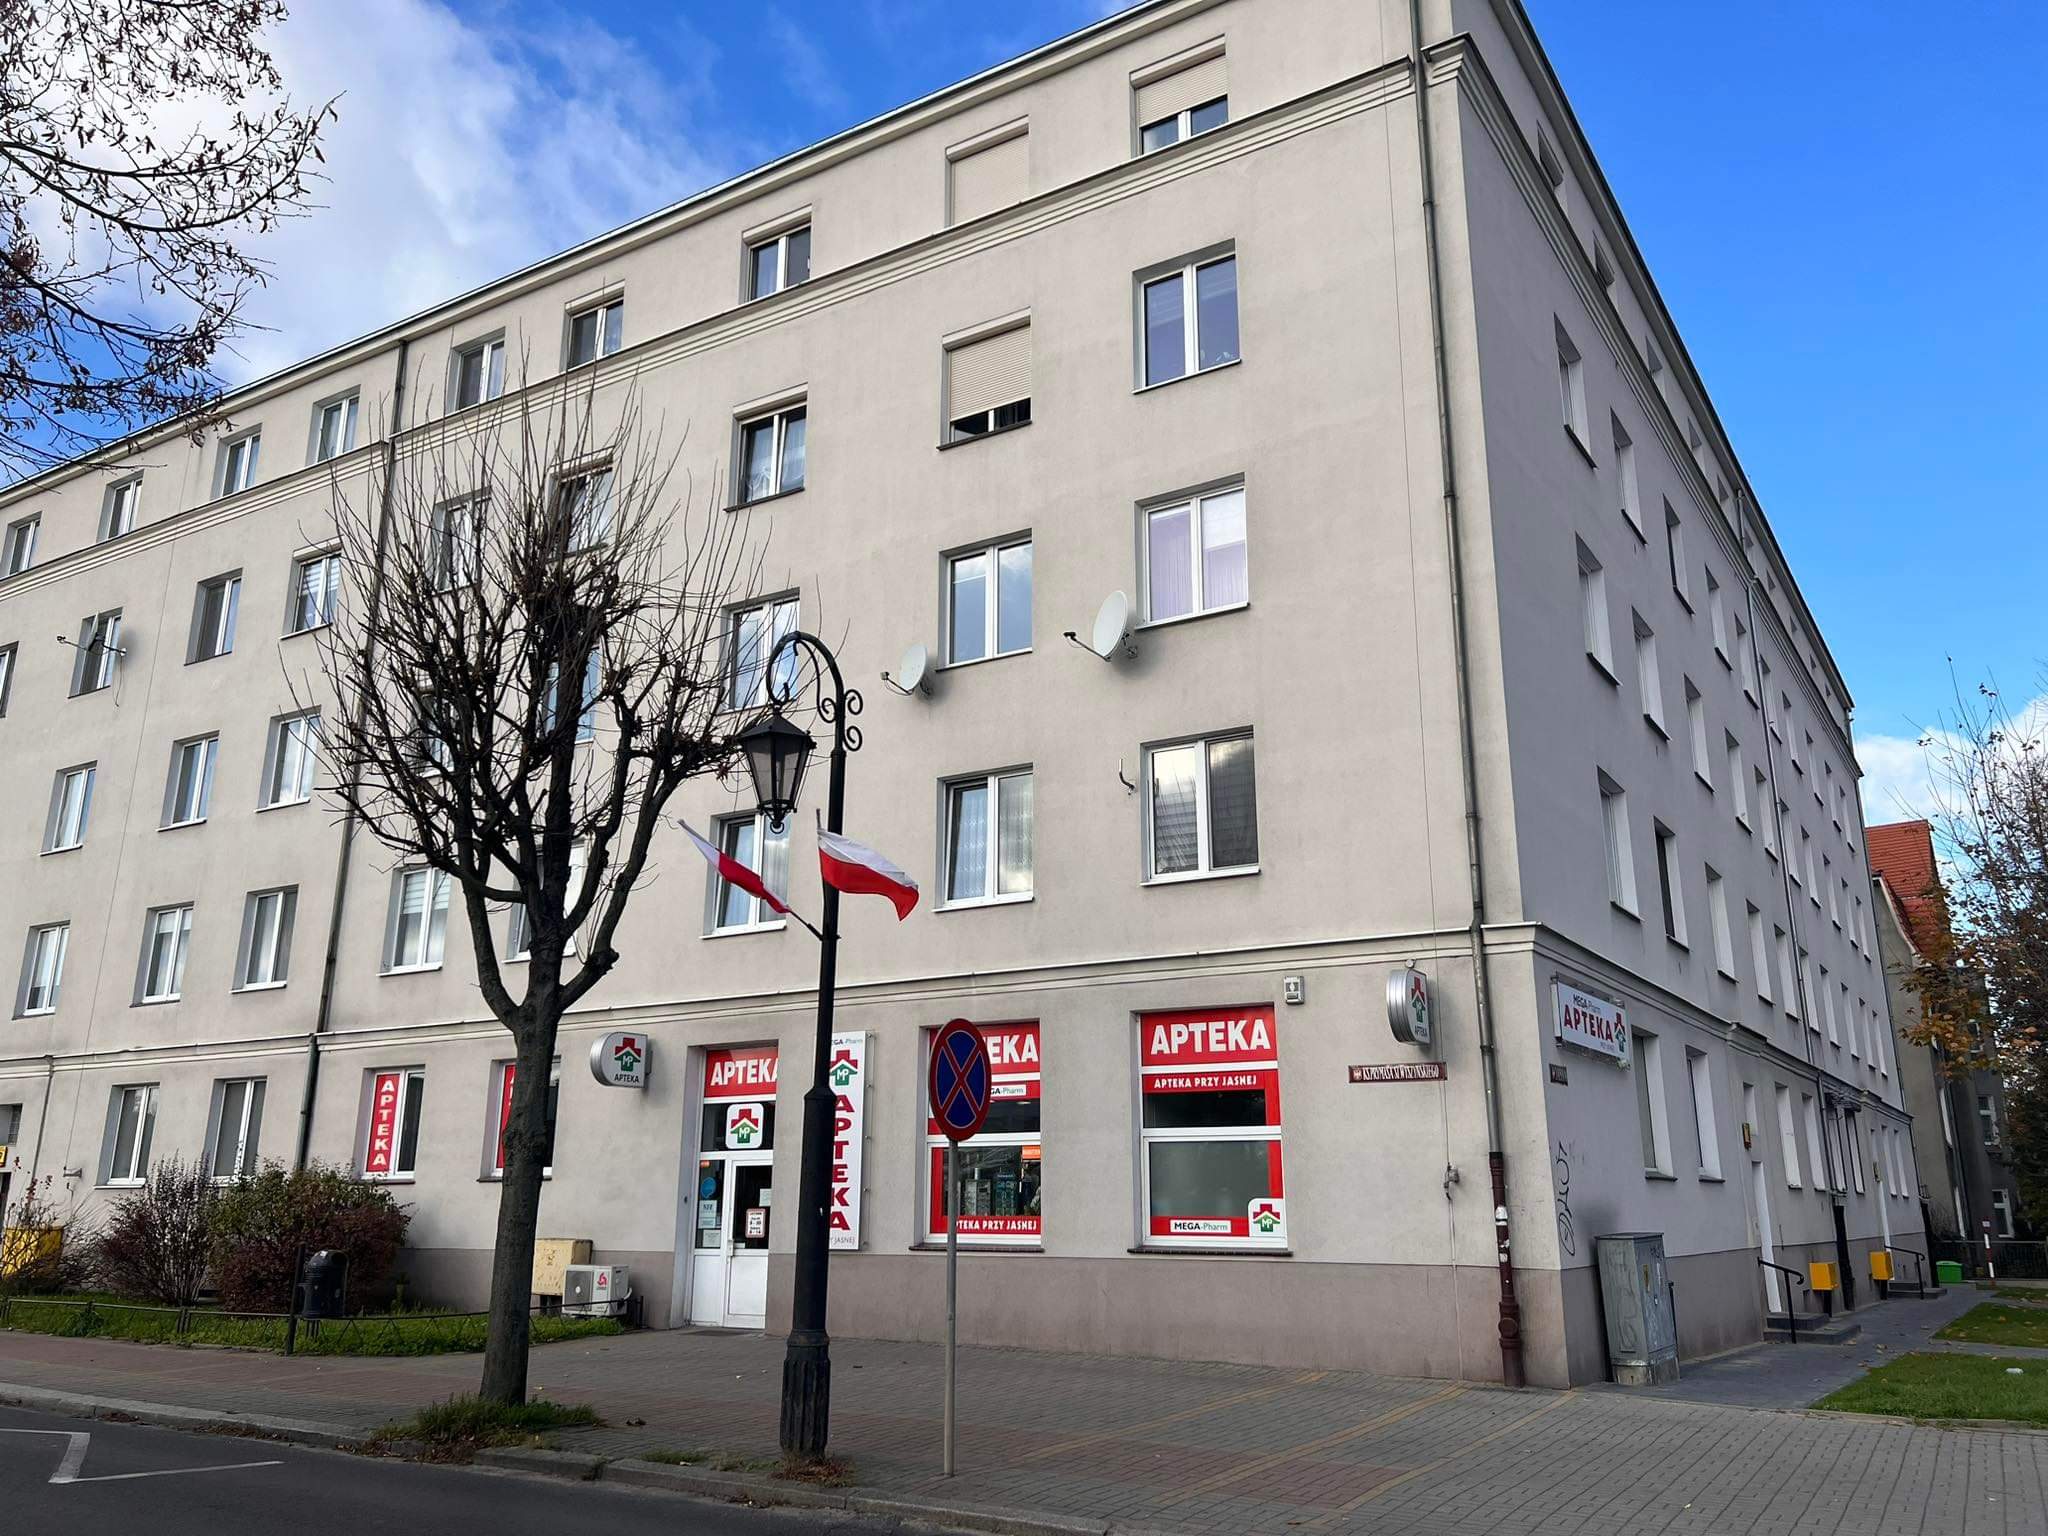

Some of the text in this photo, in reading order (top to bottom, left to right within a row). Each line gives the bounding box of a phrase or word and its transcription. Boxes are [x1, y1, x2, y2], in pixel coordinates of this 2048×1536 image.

[1150, 1019, 1271, 1055] APTEKA
[1563, 1004, 1614, 1043] APTEKA
[983, 1033, 1039, 1064] EKA
[614, 1073, 639, 1083] APTEKA
[1154, 1075, 1257, 1089] APTEKA PRZY JASNEJ
[372, 1079, 395, 1166] APTEKA
[830, 1095, 855, 1231] APTEKA
[982, 1220, 1006, 1230] PRZY
[1007, 1219, 1037, 1230] JASNEJ
[1174, 1222, 1229, 1231] MEGA-Pharm
